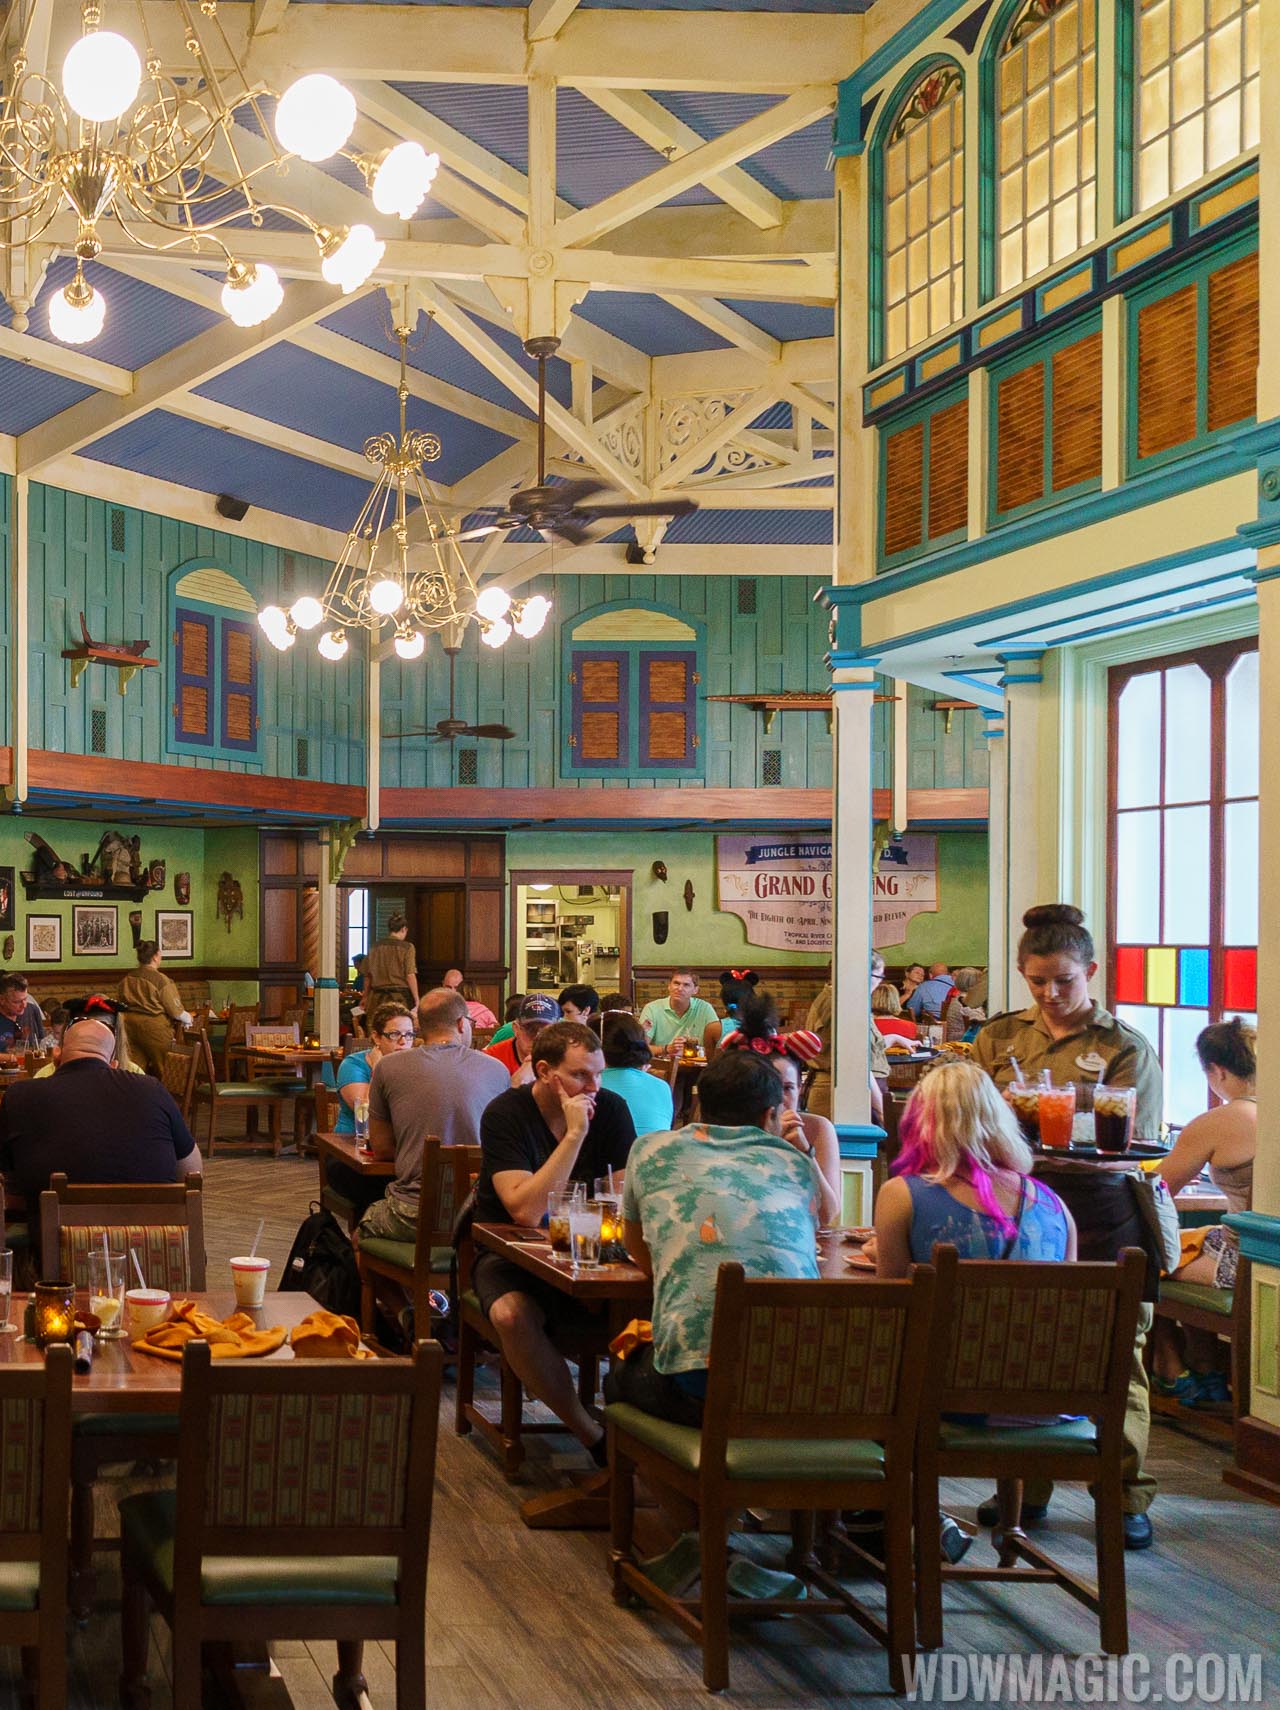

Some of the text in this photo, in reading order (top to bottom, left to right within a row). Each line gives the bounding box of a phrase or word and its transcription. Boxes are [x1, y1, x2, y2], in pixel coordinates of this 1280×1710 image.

[758, 846, 796, 858] JUNGLE
[798, 846, 833, 857] NAVIGA
[754, 872, 816, 899] GRAND
